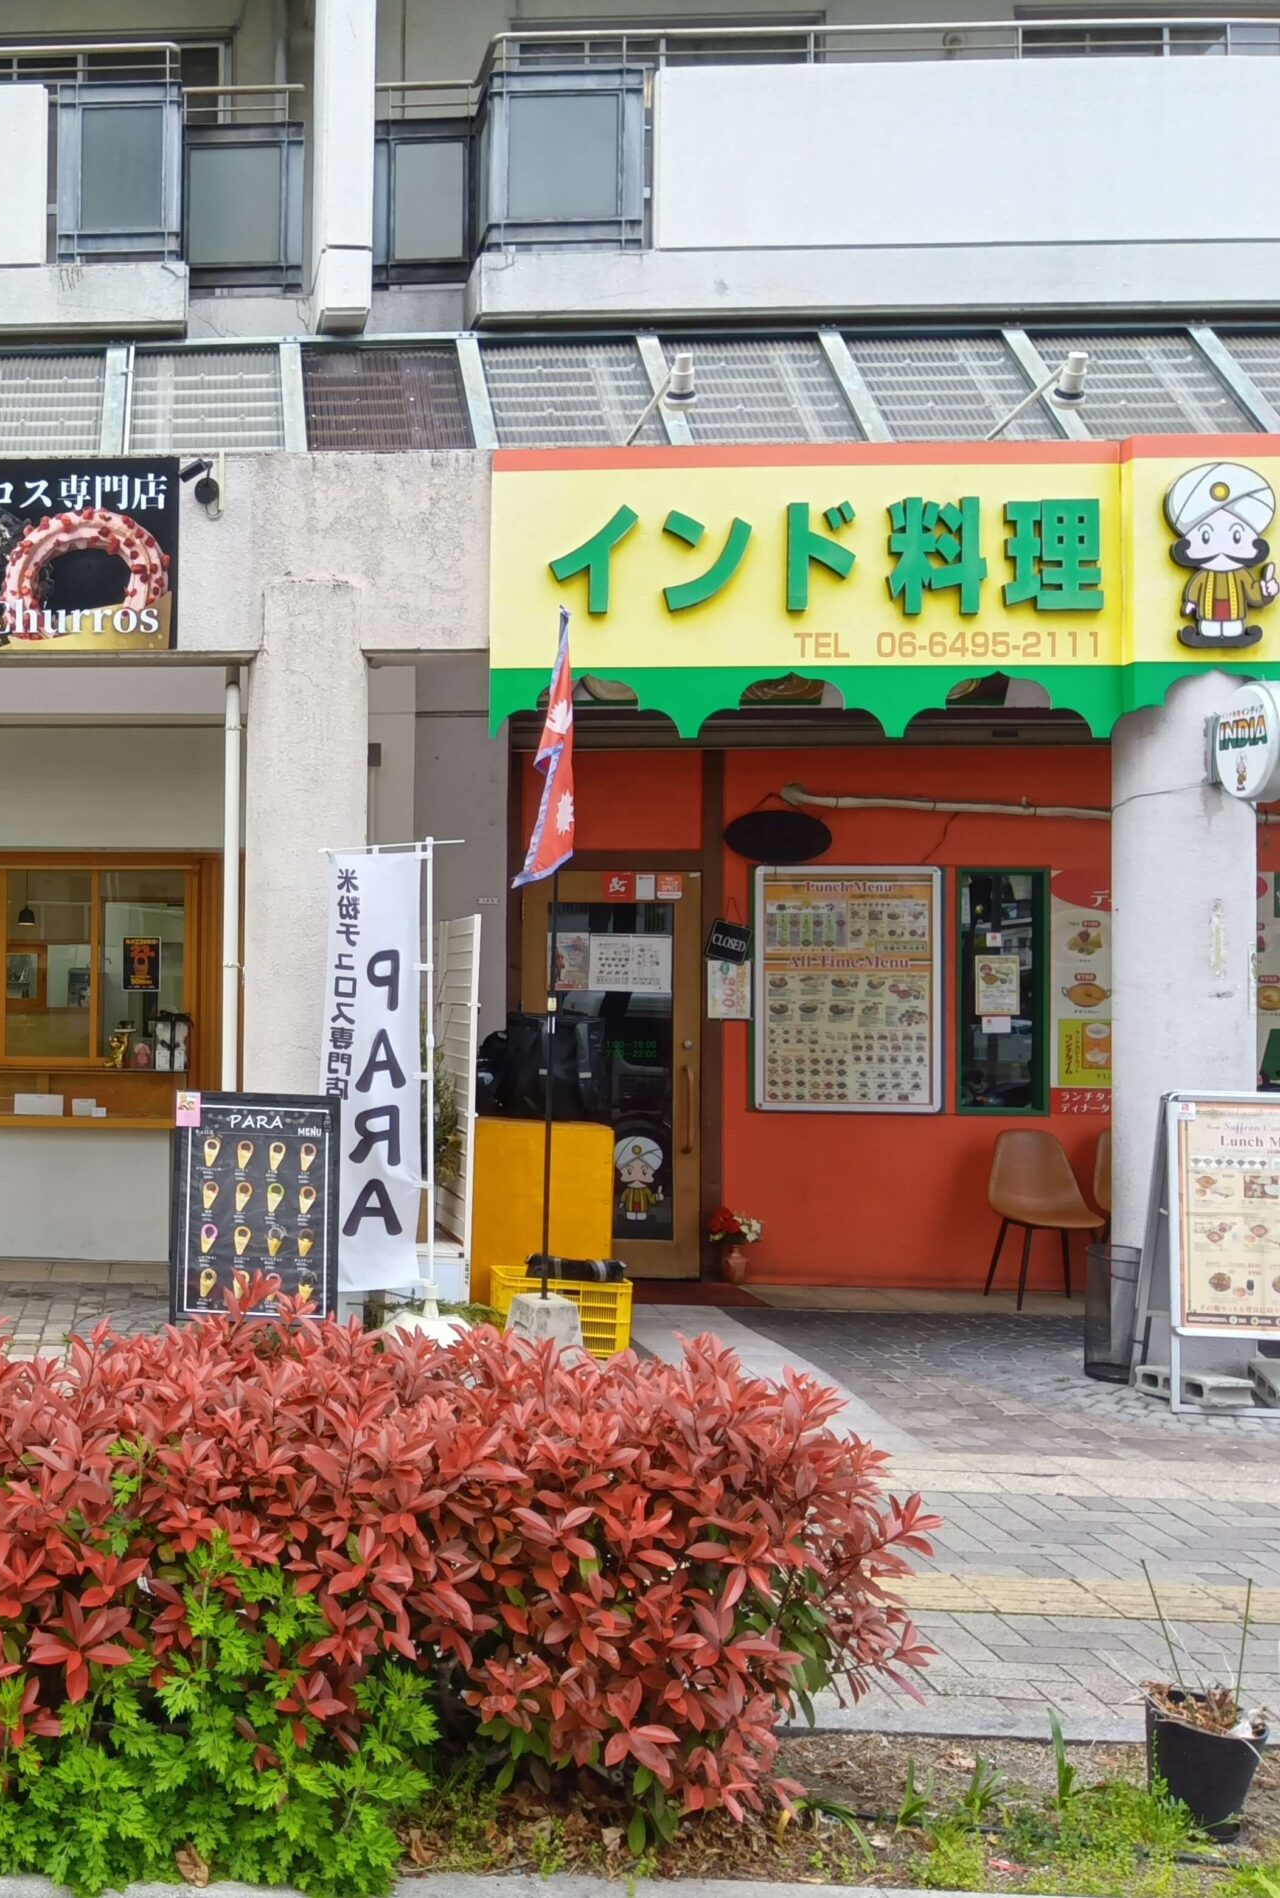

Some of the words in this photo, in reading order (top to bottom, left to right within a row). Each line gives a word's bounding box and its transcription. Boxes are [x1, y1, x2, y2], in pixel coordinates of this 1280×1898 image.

[549, 496, 1106, 617] インド料理
[793, 632, 850, 658] TEL
[876, 631, 1099, 658] 06-6495-2111
[1218, 715, 1268, 751] INDIA
[806, 881, 849, 893] Lunch
[855, 881, 893, 893] Menu
[712, 933, 746, 952] CLOSED
[864, 956, 910, 969] Menu
[230, 1114, 284, 1129] PARA
[297, 1125, 322, 1137] MENU
[1220, 1135, 1264, 1147] Lunch
